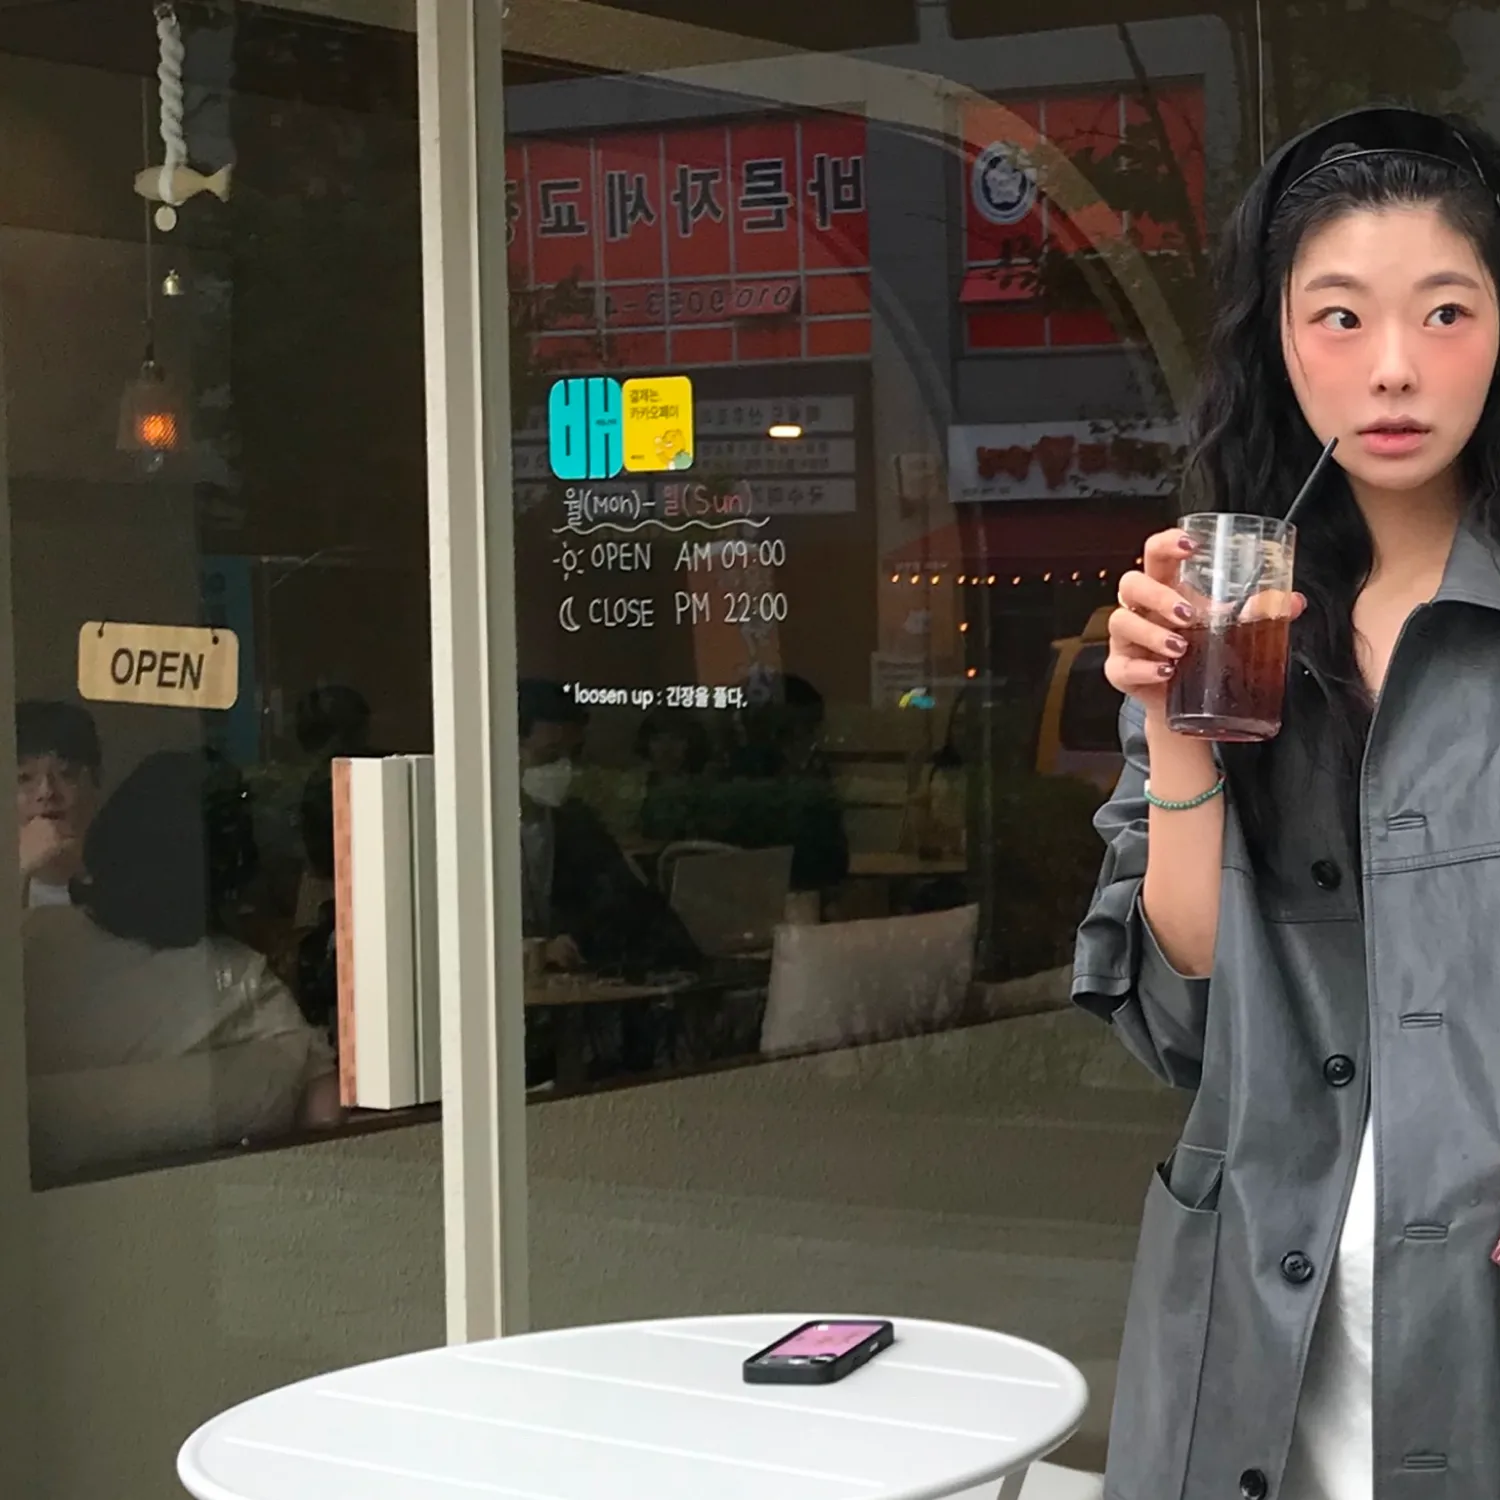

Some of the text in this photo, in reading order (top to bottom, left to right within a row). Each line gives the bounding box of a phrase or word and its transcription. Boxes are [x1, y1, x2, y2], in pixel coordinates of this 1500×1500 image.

[590, 538, 786, 573] OPEN AM 09:00
[588, 590, 789, 628] CLOSE PM 22:00
[110, 647, 205, 691] OPEN
[574, 682, 628, 705] loosen
[666, 685, 709, 708] 긴장을
[713, 685, 749, 709] 풀다.
